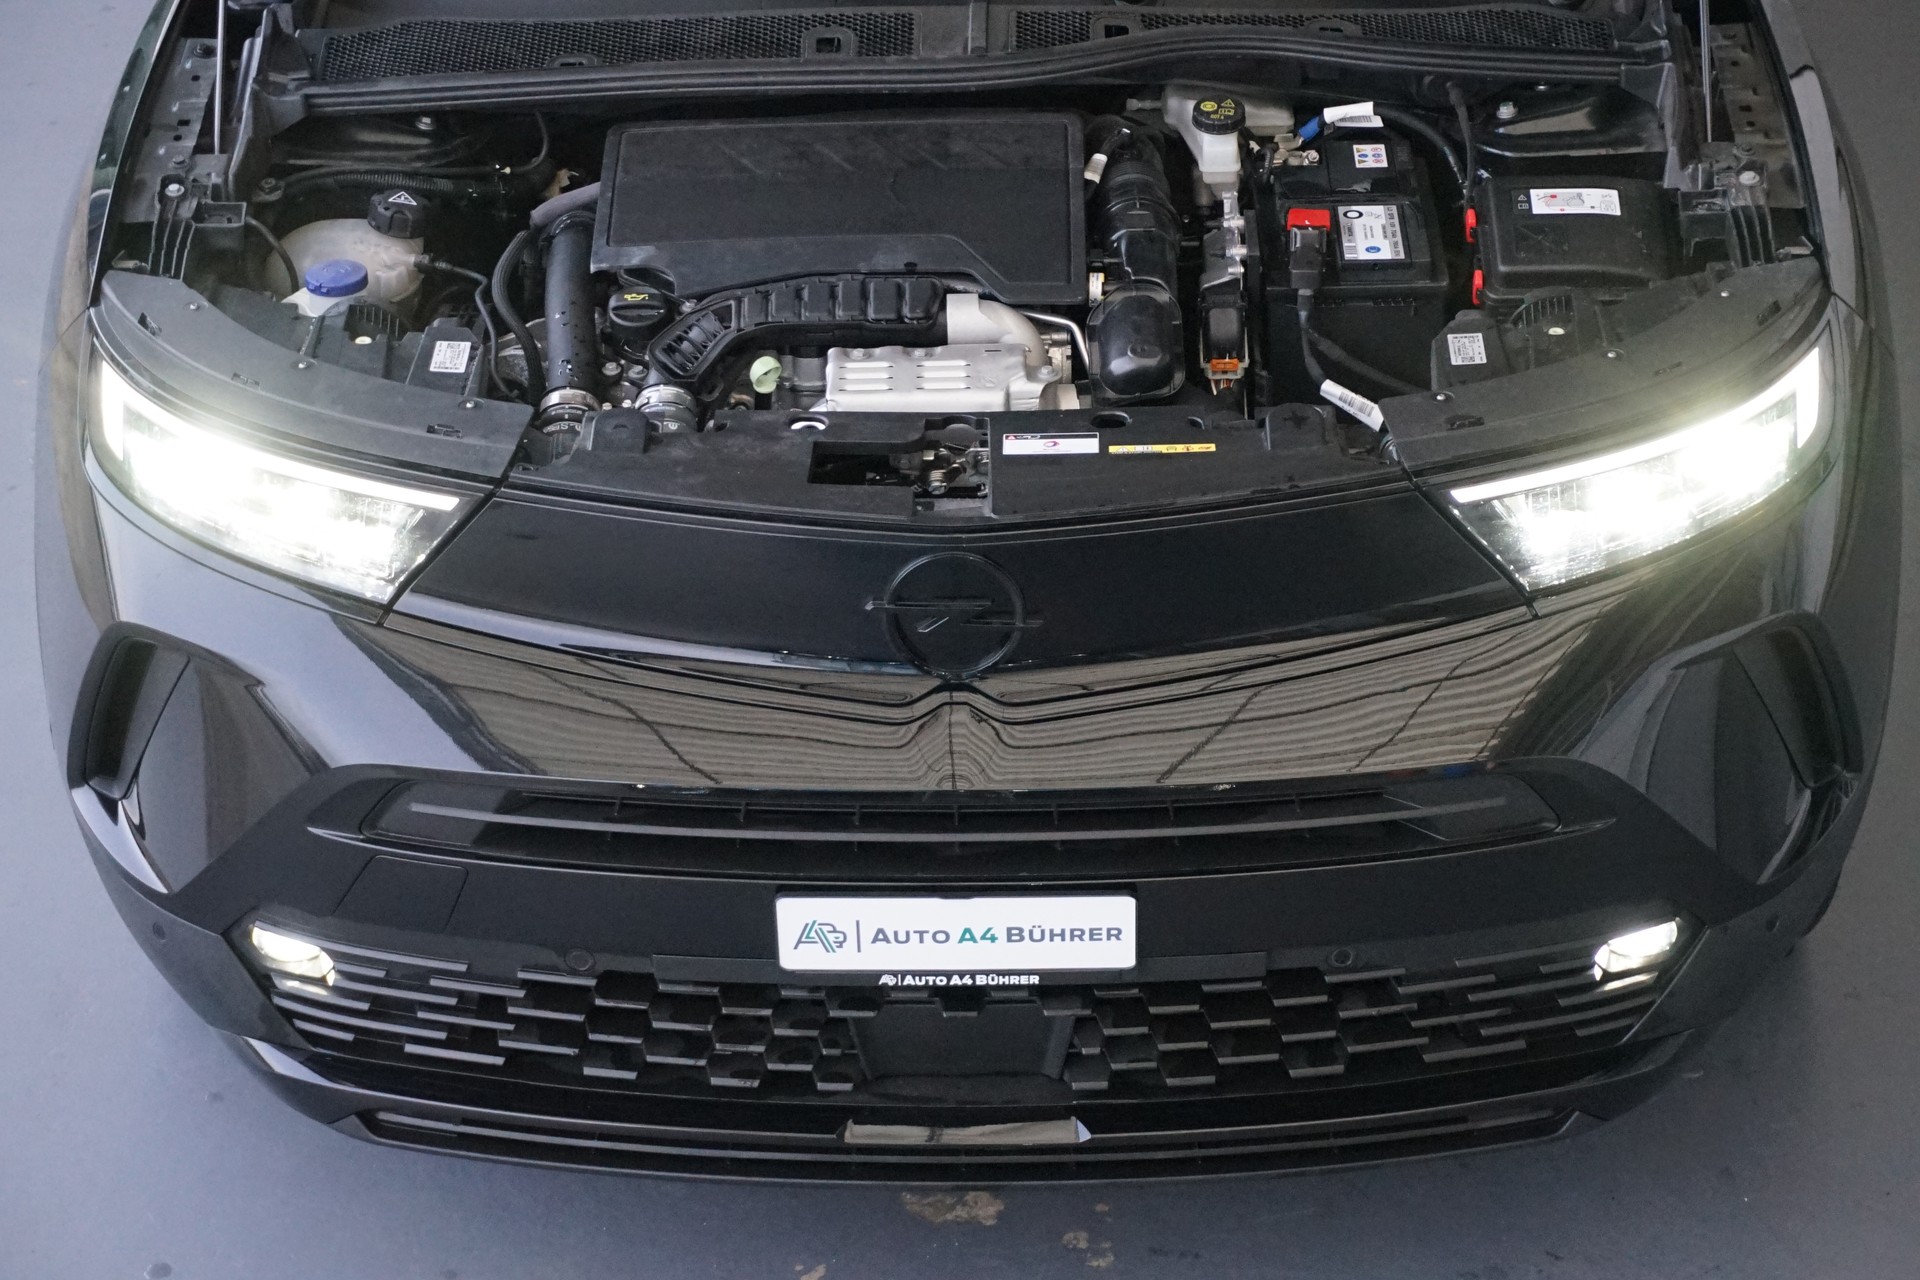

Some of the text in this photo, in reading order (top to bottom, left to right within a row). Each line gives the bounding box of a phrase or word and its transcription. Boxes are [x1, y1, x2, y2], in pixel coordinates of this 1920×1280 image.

[871, 925, 1123, 944] AUTO A4 BÜHRER
[903, 973, 1040, 986] AUTO A4 BÜHRER
